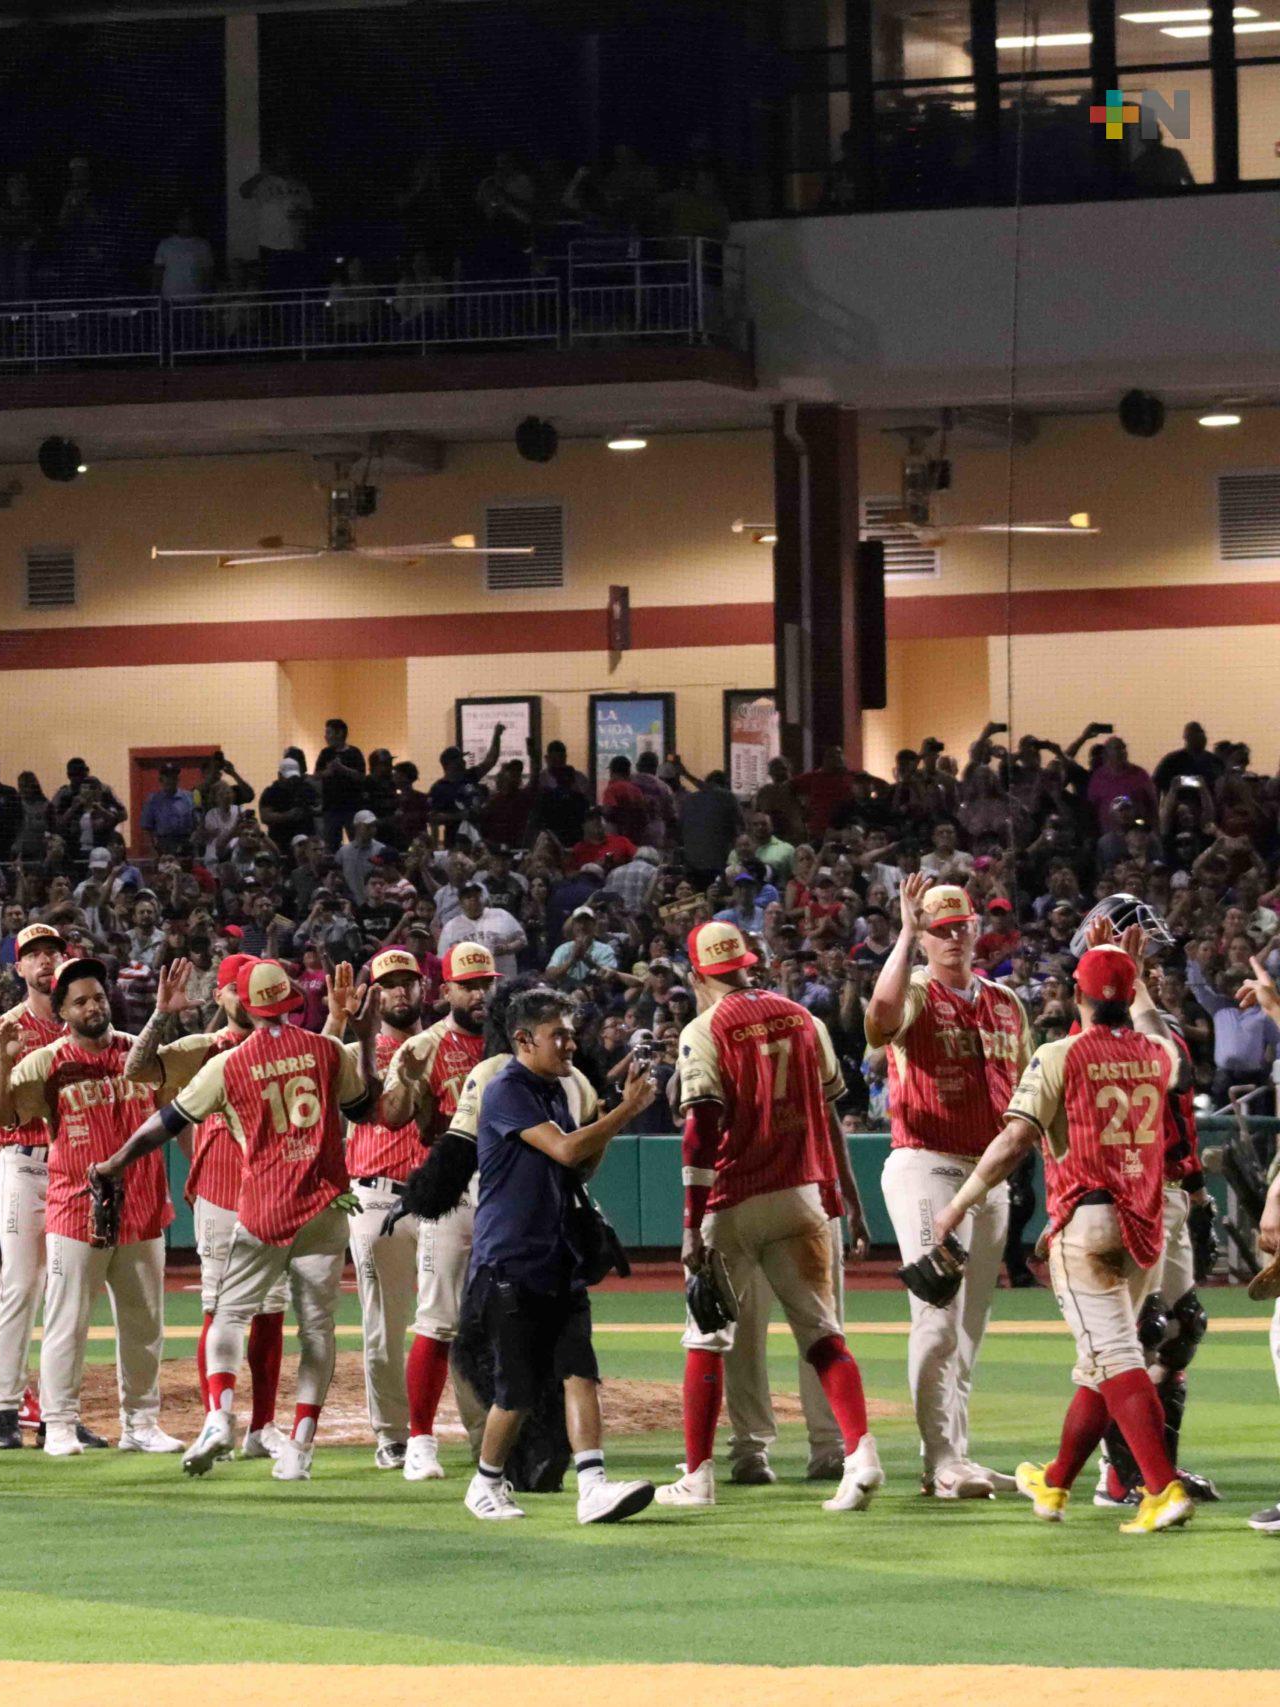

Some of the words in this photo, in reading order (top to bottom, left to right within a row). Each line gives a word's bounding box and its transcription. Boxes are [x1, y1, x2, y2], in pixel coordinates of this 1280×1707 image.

[597, 710, 618, 721] LA
[705, 937, 740, 959] TECOS
[378, 954, 410, 968] TECOS
[459, 953, 490, 967] TECOS
[257, 980, 288, 1001] TECOS
[250, 1053, 316, 1081] HARRIS
[760, 1038, 791, 1100] 7
[1087, 1060, 1161, 1080] CASTILLO
[261, 1075, 321, 1134] 16
[1096, 1083, 1159, 1145] 22
